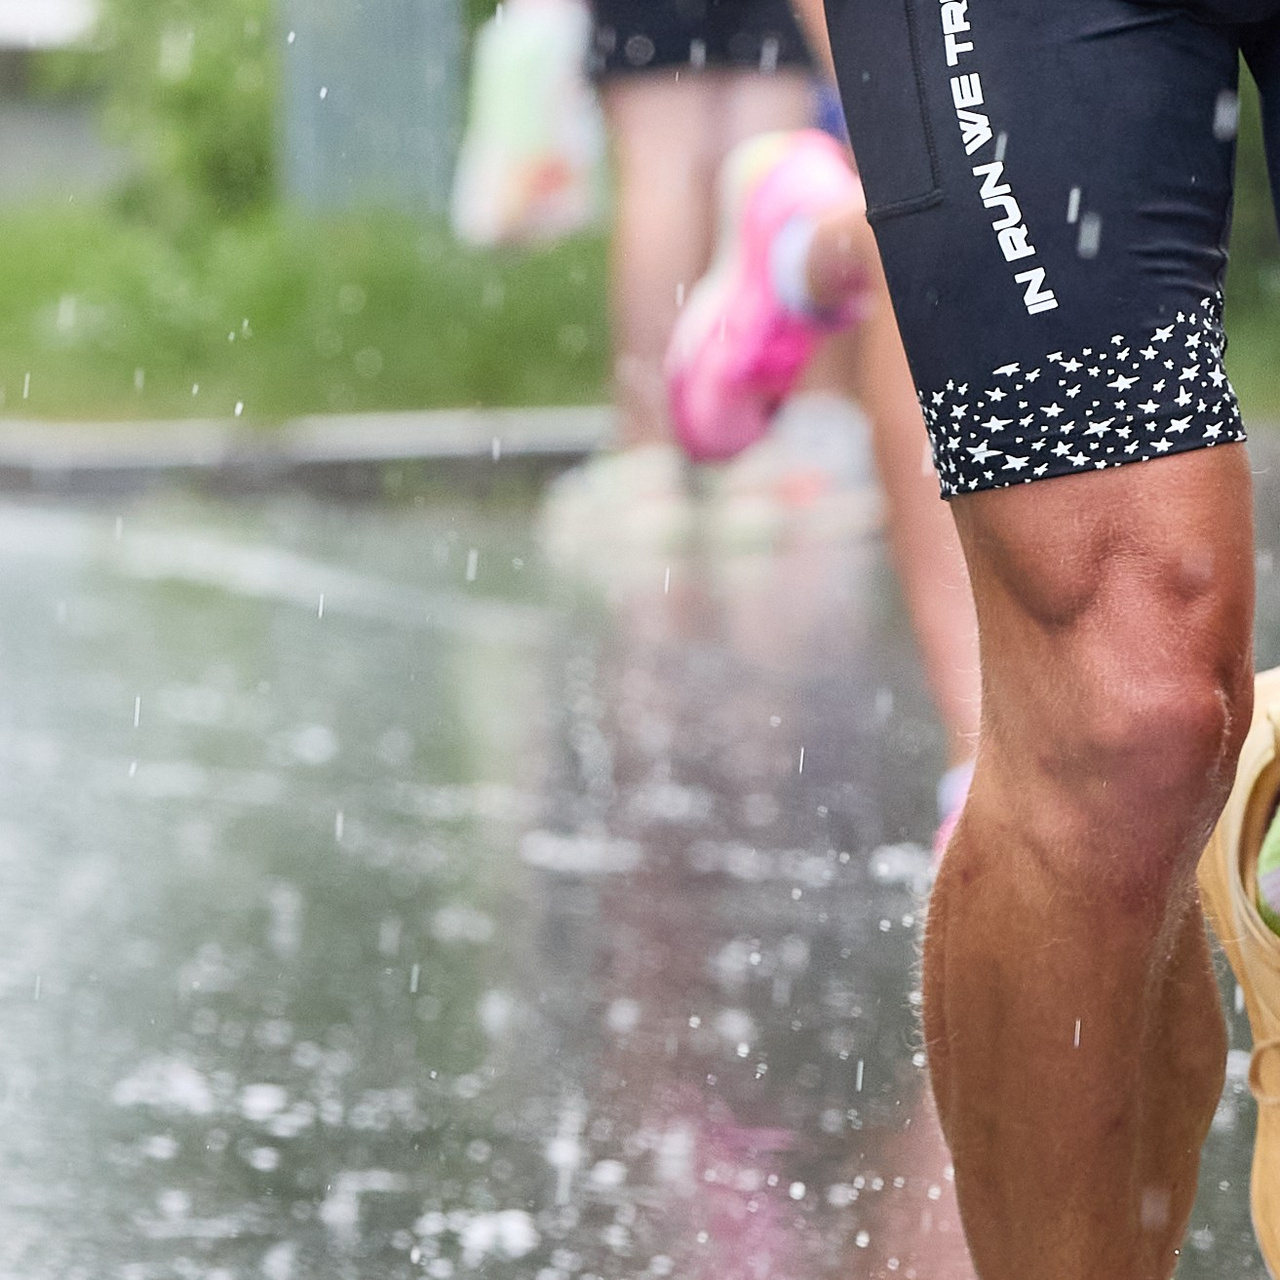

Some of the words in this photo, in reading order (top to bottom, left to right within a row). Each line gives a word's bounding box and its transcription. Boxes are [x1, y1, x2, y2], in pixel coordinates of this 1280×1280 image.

[950, 72, 993, 156] WE
[972, 161, 1036, 262] RUN
[1014, 267, 1060, 315] IN
